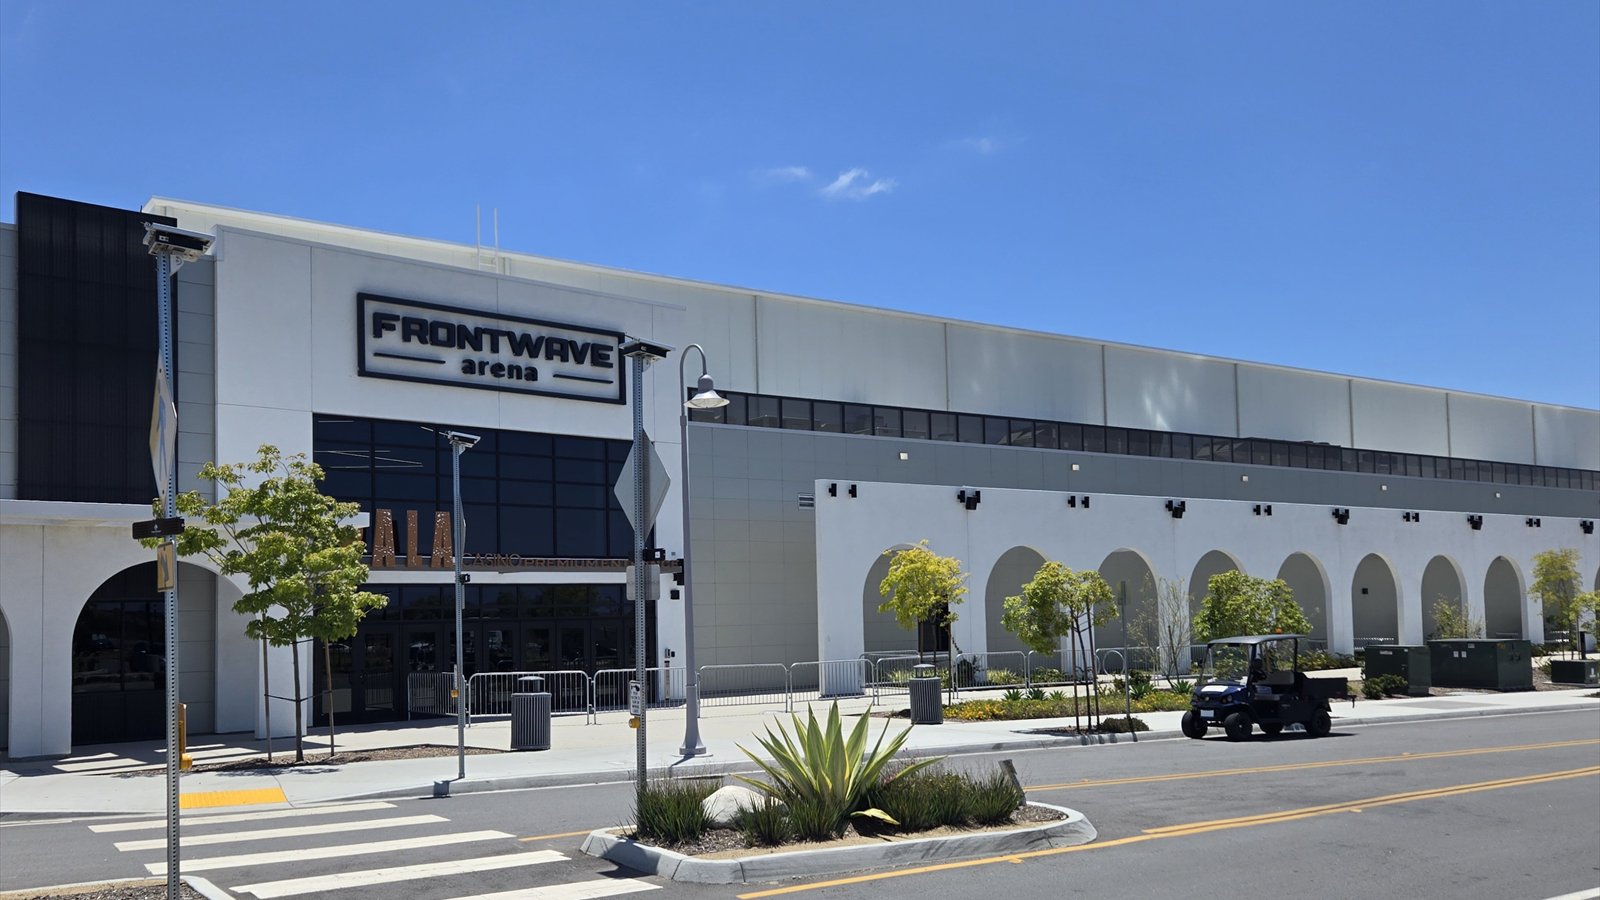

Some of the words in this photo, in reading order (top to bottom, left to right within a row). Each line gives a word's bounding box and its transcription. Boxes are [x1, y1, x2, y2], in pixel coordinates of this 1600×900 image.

[372, 311, 614, 368] FRONTWAVE
[461, 357, 539, 381] arena
[341, 508, 454, 568] ALA
[462, 552, 522, 568] CASINO
[524, 558, 597, 568] PREMIUM
[602, 559, 679, 568] ENTCE
